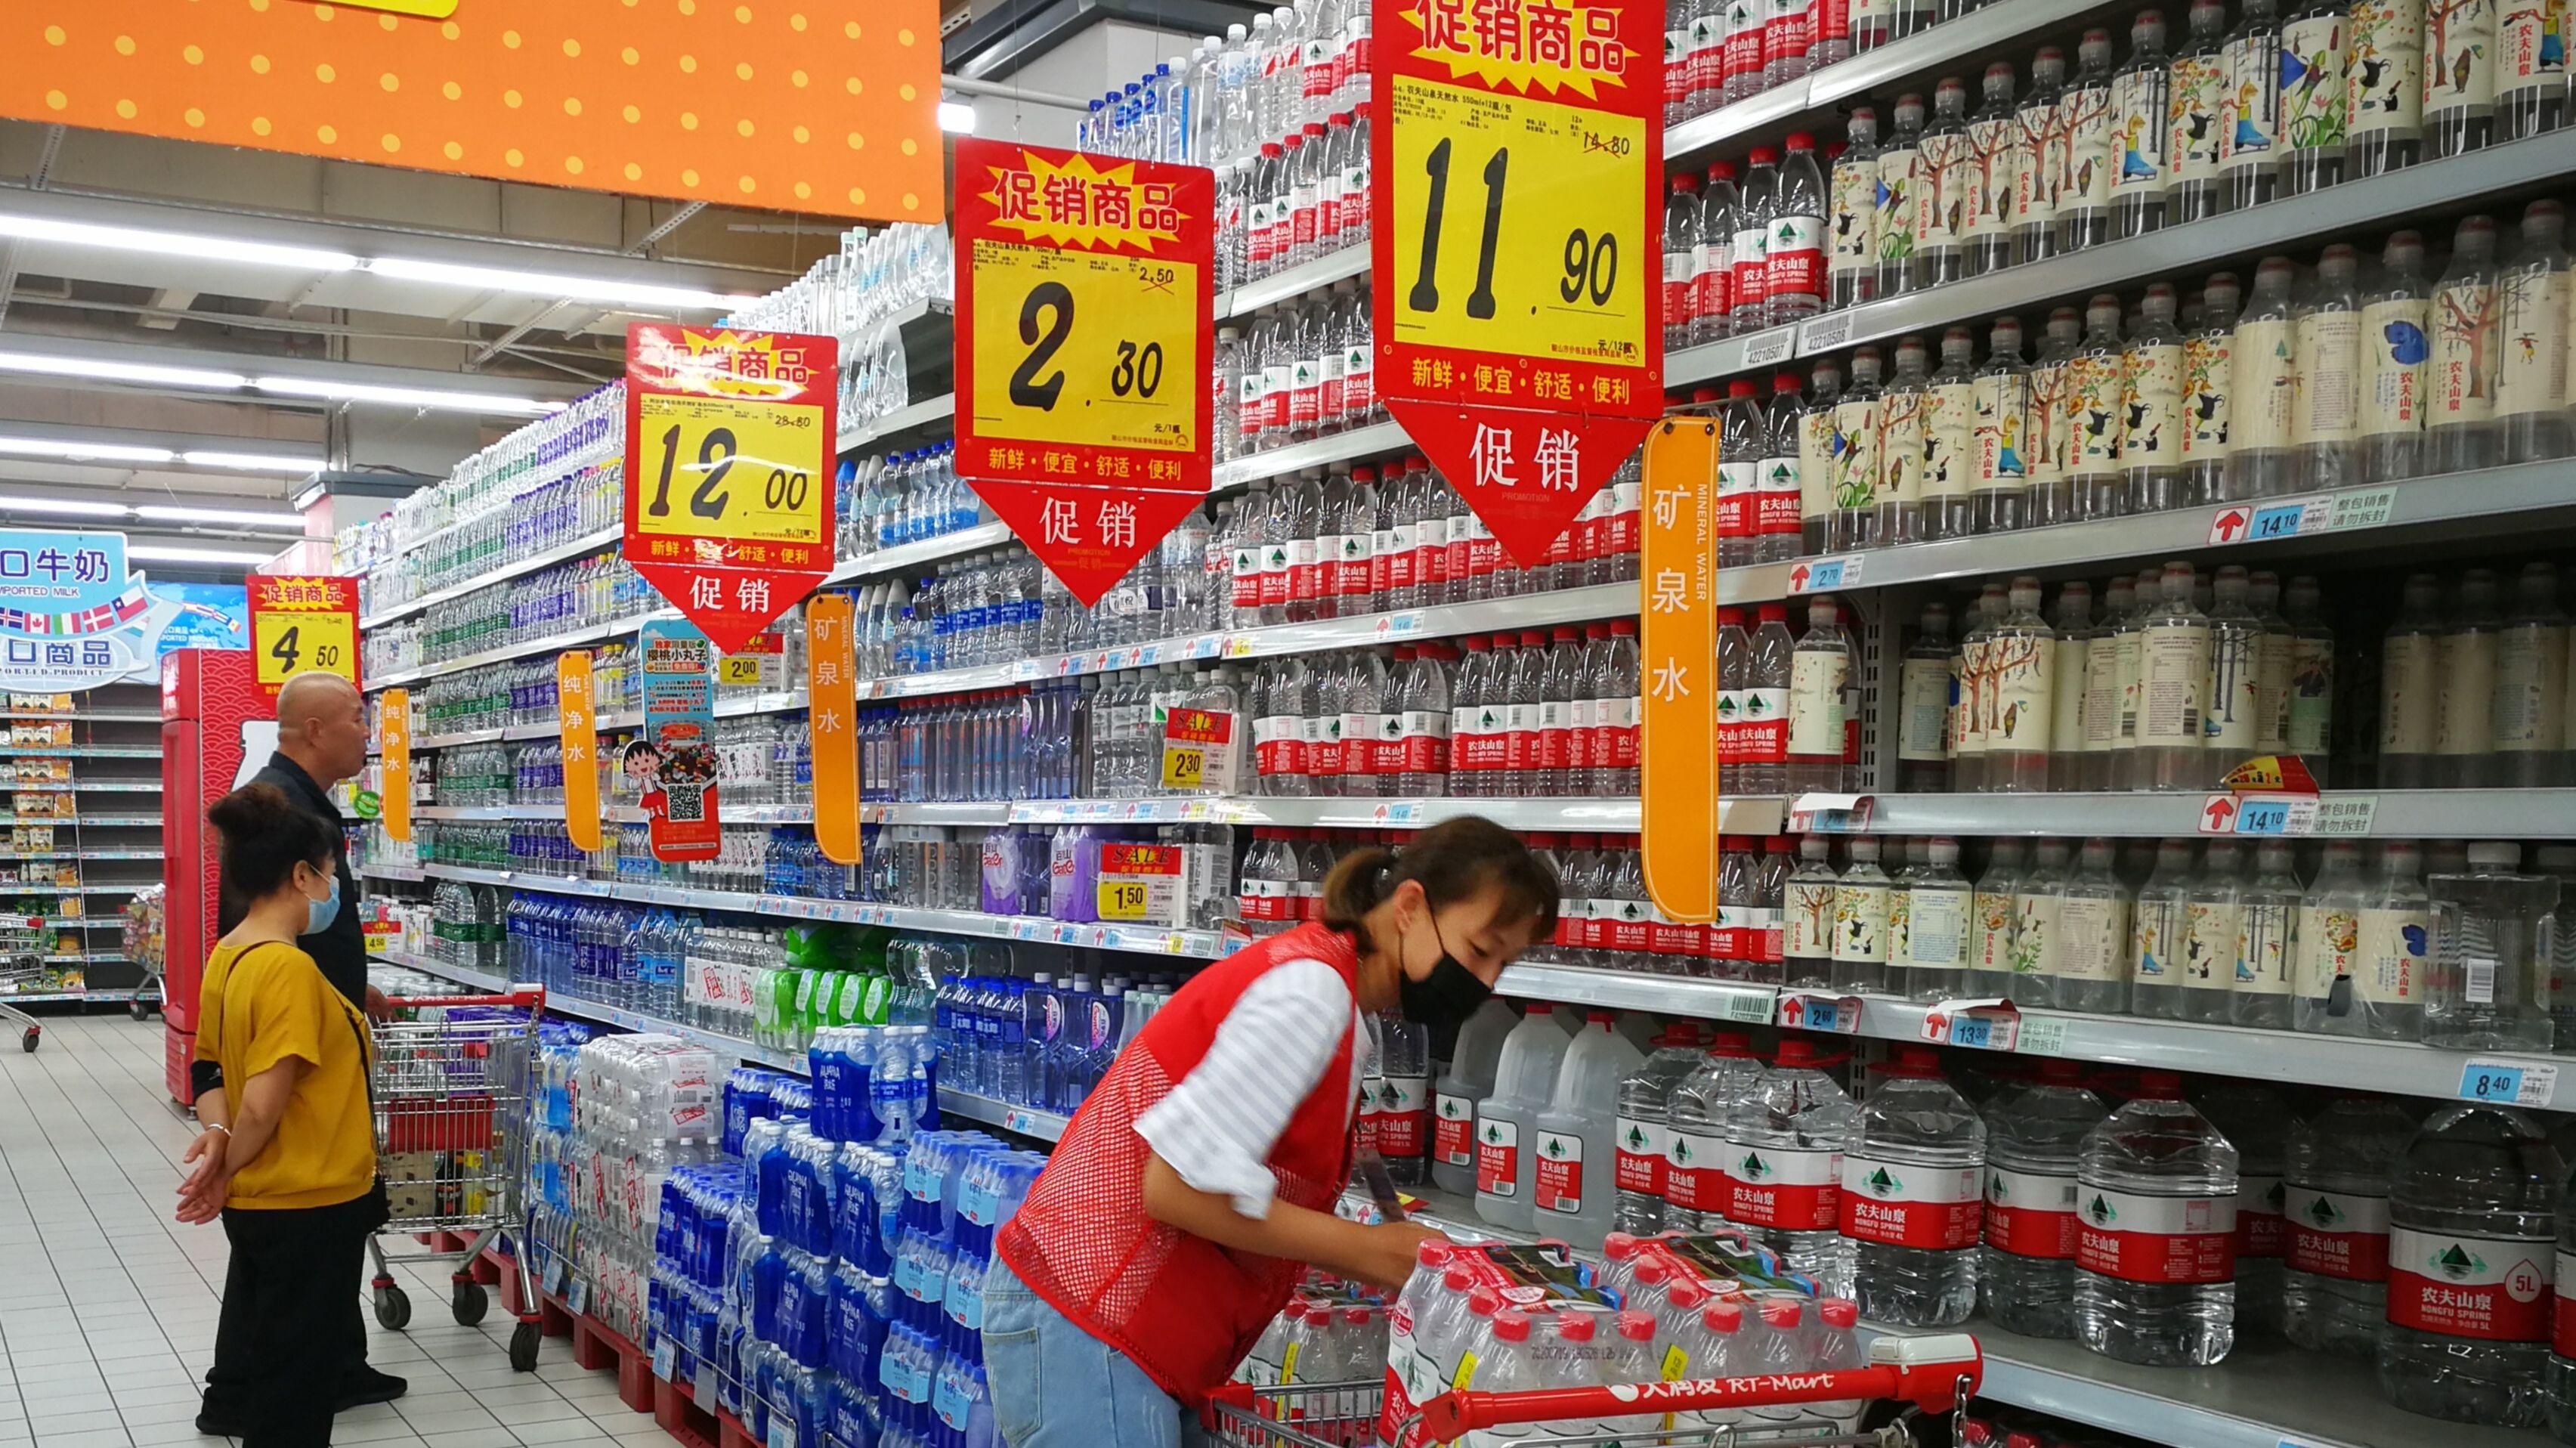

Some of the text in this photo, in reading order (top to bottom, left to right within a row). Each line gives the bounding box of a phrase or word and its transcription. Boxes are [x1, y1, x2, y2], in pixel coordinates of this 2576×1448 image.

[1421, 0, 1626, 75] 促销商品
[2518, 25, 2531, 77] 农夫山泉
[1406, 85, 1458, 102] 农夫山泉天然水
[994, 167, 1179, 233] 促销商品
[1140, 266, 1174, 283] 2.50
[1743, 269, 1764, 280] 农夫
[1767, 257, 1809, 272] 农夫山泉
[2400, 371, 2413, 421] 农夫山泉
[2449, 361, 2463, 411] 农夫山泉
[2071, 422, 2082, 466] 农夫山泉
[1469, 421, 1579, 493] 促销
[1984, 438, 1993, 479] 农夫山泉
[1717, 502, 1740, 515] 山泉
[2337, 493, 2390, 512] 整包销售
[1040, 497, 1136, 549] 促销
[2333, 510, 2386, 528] 请勿拆封
[1697, 484, 1707, 601] MINERAL WATER
[0, 548, 109, 583] 口牛奶
[54, 586, 79, 597] MILK
[1263, 577, 1285, 587] 农夫山
[264, 584, 342, 603] 促销商品
[690, 574, 769, 613] 促销
[1652, 484, 1691, 703] 矿泉水
[8, 638, 111, 666] 口商品
[648, 649, 707, 661] 樱桃小丸子
[815, 617, 841, 733] 矿泉水
[564, 675, 586, 763] 纯净水
[1174, 711, 1223, 732] SALE
[385, 705, 400, 772] 纯净水
[2319, 803, 2370, 817] 整包销售
[2315, 818, 2367, 833] 请勿拆封
[1112, 846, 1172, 865] SALE
[1114, 886, 1143, 910] 1.50
[2335, 955, 2346, 975] 农夫
[2398, 958, 2411, 997] 农夫山泉
[1380, 1119, 1412, 1134] 夫山泉
[1620, 1156, 1653, 1174] 农夫山泉
[1668, 1170, 1696, 1189] 农夫山泉
[1733, 1187, 1775, 1207] 农夫山泉
[1855, 1202, 1906, 1224] 农夫山泉
[1854, 1217, 1905, 1233] NONGFU SPRING
[2250, 1220, 2278, 1234] 农夫
[2081, 1231, 2120, 1255] 农夫山泉
[2297, 1233, 2350, 1255] 农夫山泉
[2516, 1275, 2535, 1292] 5L
[2420, 1286, 2492, 1311] 农夫山泉
[2420, 1304, 2492, 1322] NONGFU SPRING
[2479, 1322, 2491, 1331] 5L
[1726, 1372, 1835, 1394] RT-Mart
